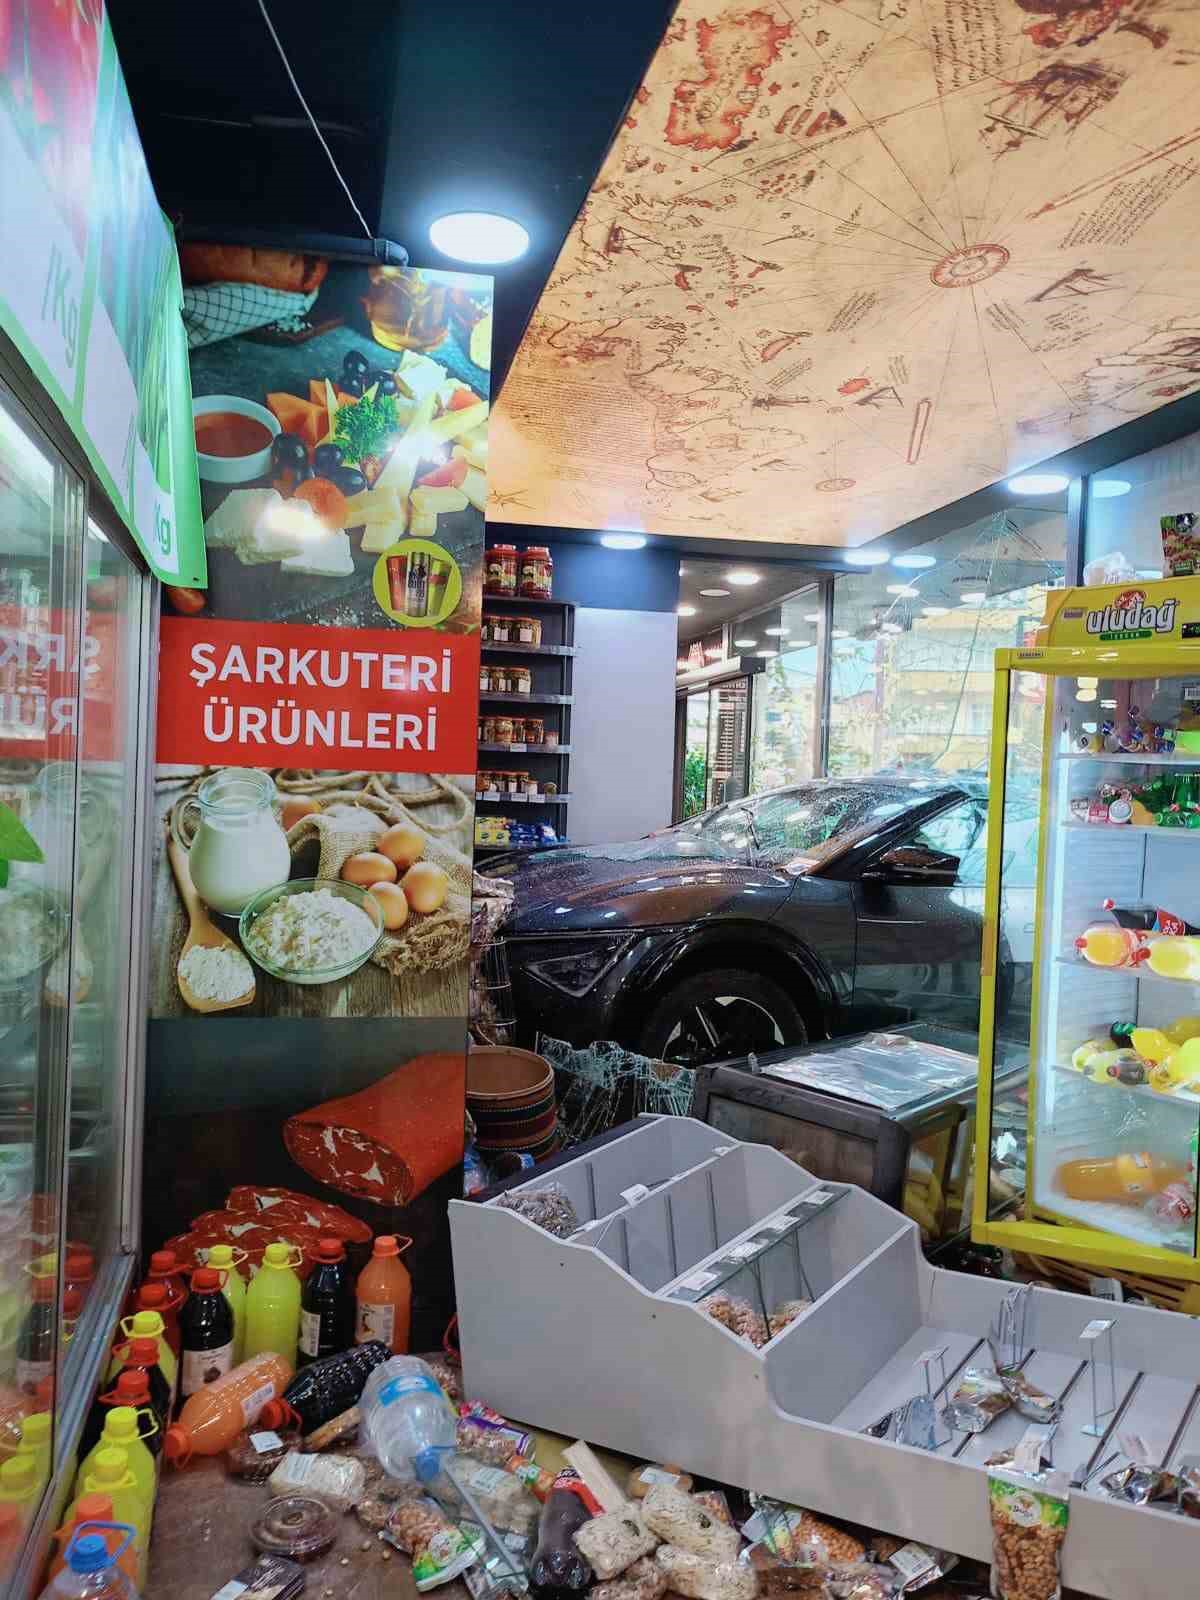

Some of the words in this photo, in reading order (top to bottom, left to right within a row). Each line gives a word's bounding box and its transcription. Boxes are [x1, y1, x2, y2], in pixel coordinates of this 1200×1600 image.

[1086, 598, 1177, 633] uludağ
[188, 643, 452, 693] ŞARKUTERİ
[203, 696, 437, 751] ÜRÜNLERİ
